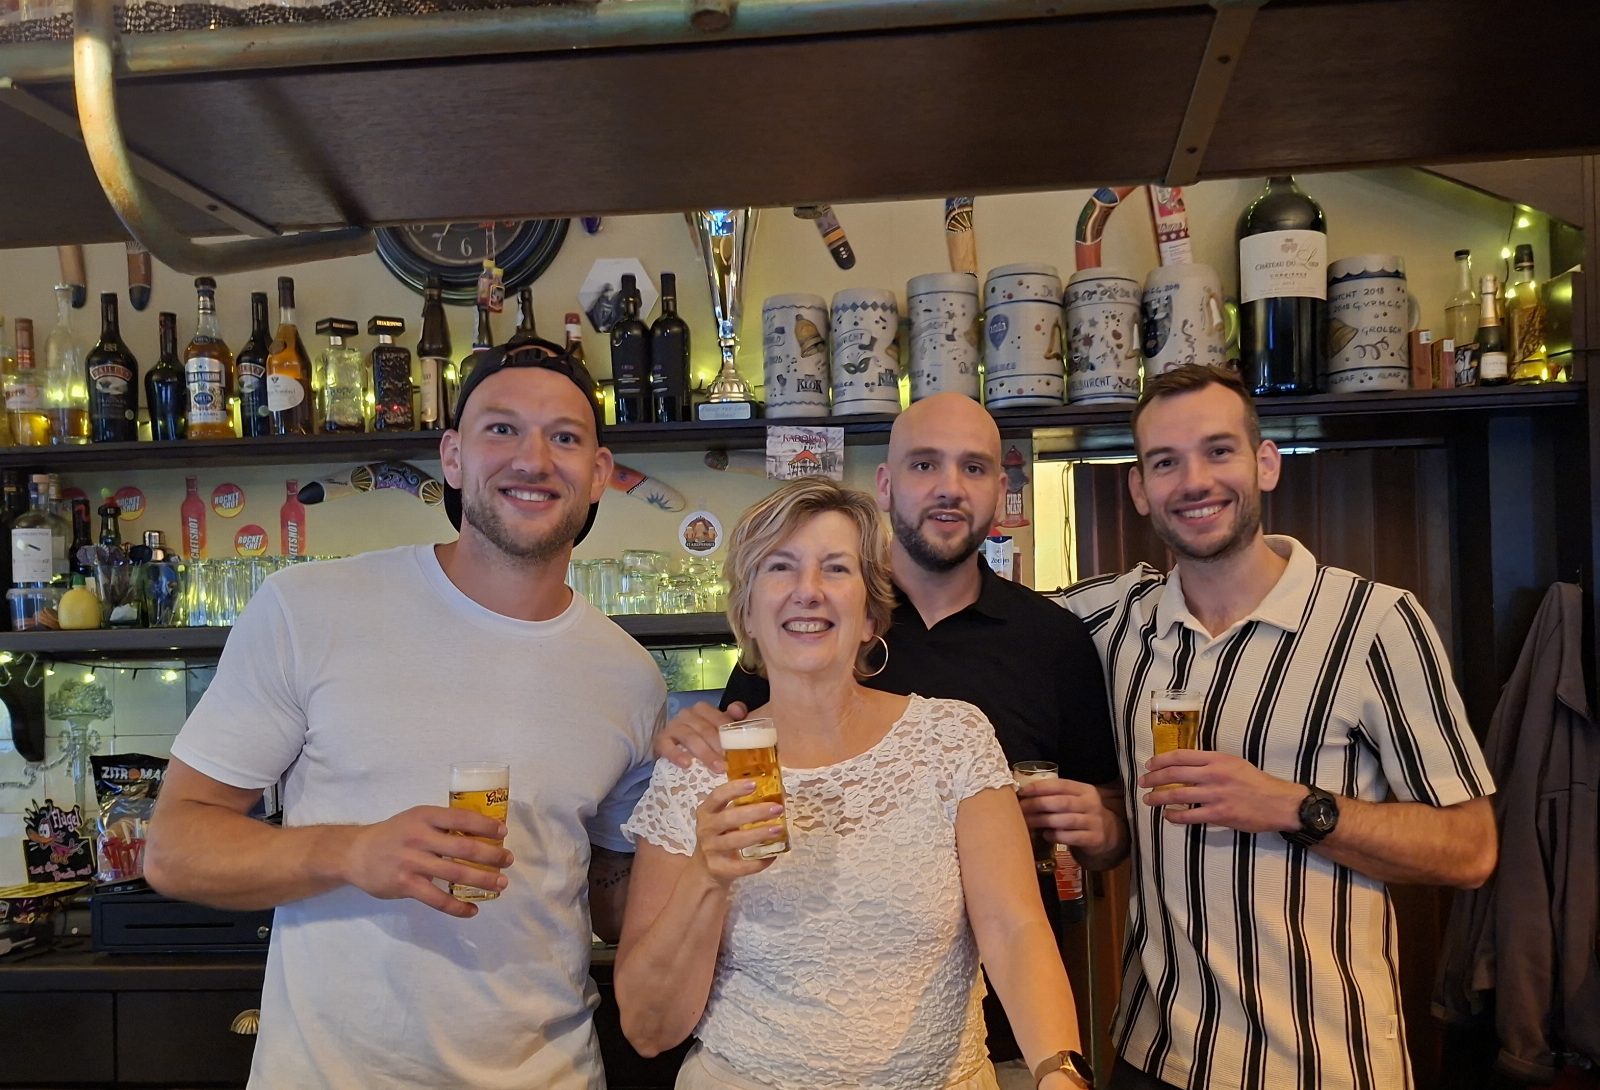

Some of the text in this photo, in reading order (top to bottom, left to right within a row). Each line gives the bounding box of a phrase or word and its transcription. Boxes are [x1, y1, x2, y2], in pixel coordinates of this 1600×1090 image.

[460, 237, 472, 257] 6
[214, 491, 240, 505] ROCKET
[1006, 493, 1022, 504] FIRE
[222, 500, 240, 510] SHOT
[1006, 503, 1022, 515] MAN
[189, 516, 200, 560] CKETSHOT
[237, 534, 264, 545] ROCKET
[244, 542, 261, 551] SHOT
